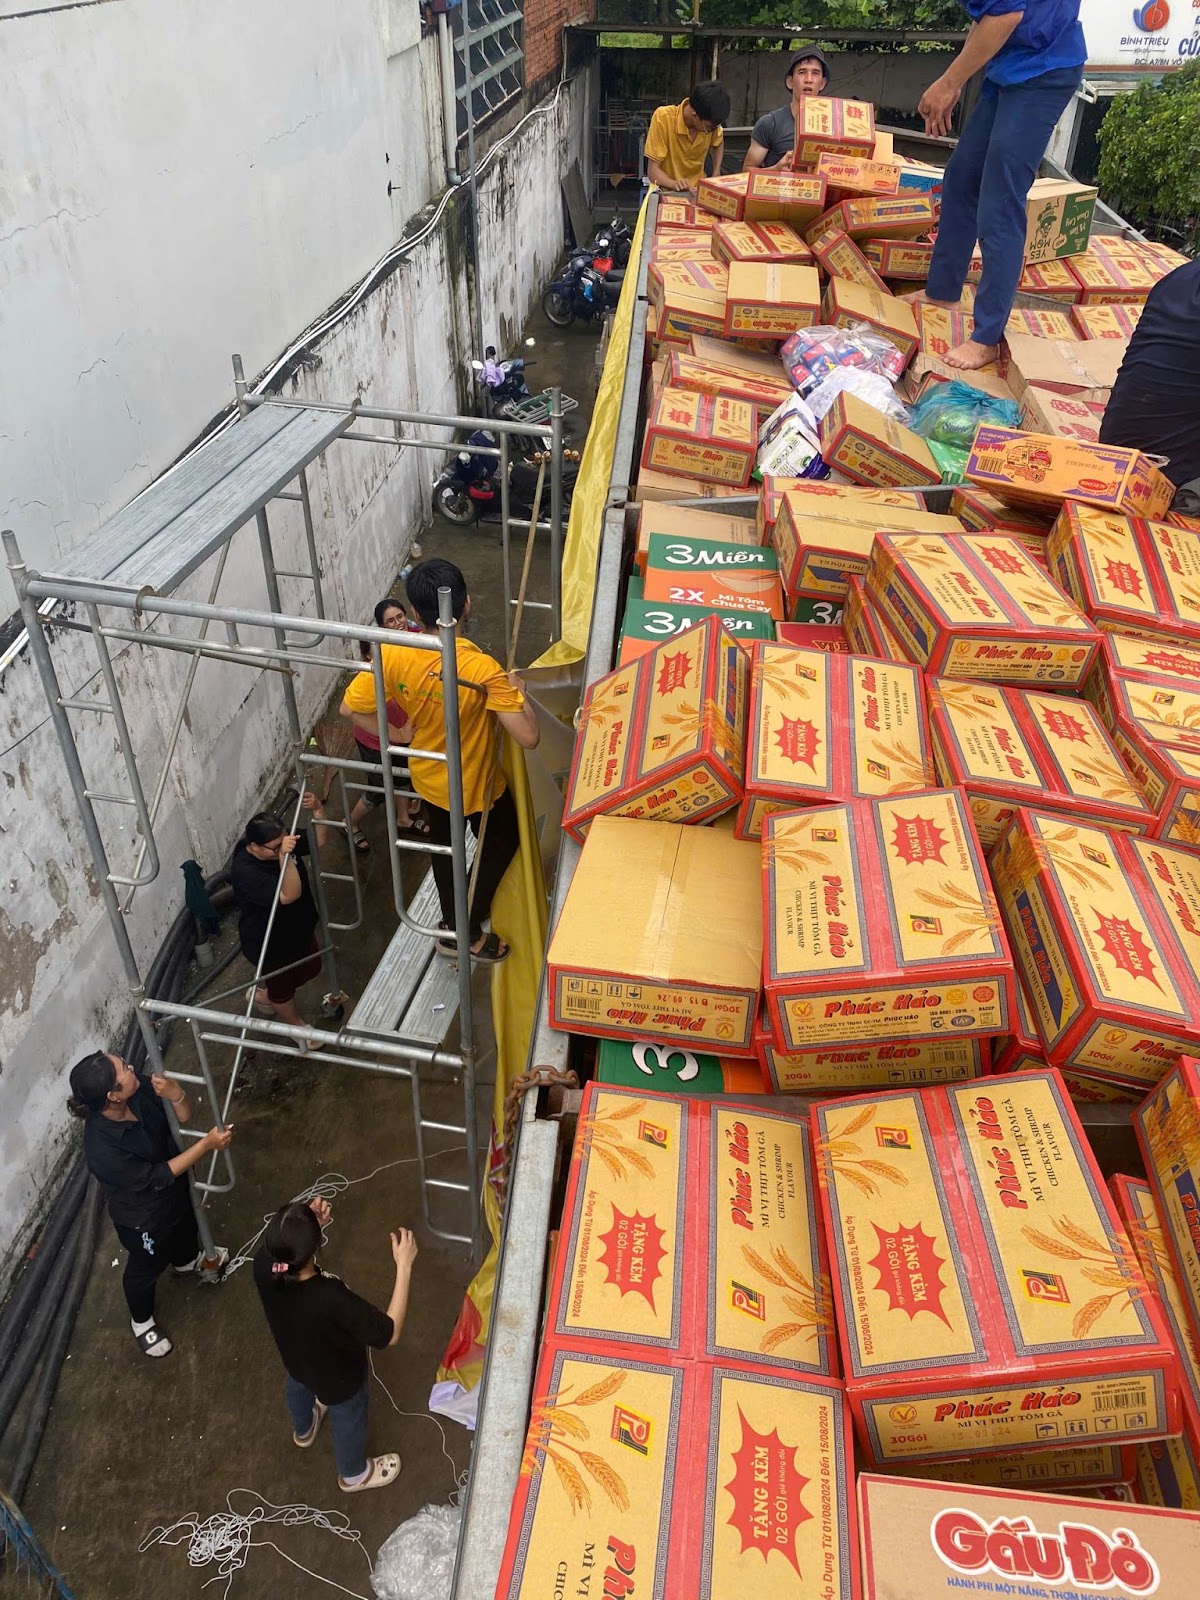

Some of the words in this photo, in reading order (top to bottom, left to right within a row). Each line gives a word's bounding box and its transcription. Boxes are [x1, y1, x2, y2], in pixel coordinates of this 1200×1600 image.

[1120, 35, 1141, 45] BÌNH
[1144, 37, 1169, 47] TRIỆU
[1178, 31, 1200, 56] CỬ
[1030, 251, 1046, 259] YES
[669, 588, 704, 602] 2X
[711, 599, 744, 609] Chua
[747, 602, 772, 613] Cay
[974, 645, 1018, 660] Phúc
[1020, 645, 1053, 661] Hảo
[822, 875, 846, 916] Phúc
[828, 921, 854, 958] Hảo
[606, 1007, 648, 1026] Hảo
[824, 997, 886, 1019] Phúc
[892, 989, 942, 1011] Hảo
[652, 1012, 707, 1032] Phúc
[904, 1013, 919, 1021] HẢO
[1001, 1098, 1014, 1113] GÀ
[969, 1097, 1004, 1141] Hảo
[1008, 1115, 1023, 1141] TÔM
[1024, 1107, 1041, 1138] SHRIMP
[725, 1121, 750, 1165] Hảo
[756, 1131, 766, 1145] GÀ
[1042, 1123, 1063, 1161] FLAVOUR
[757, 1146, 767, 1169] TÔM
[774, 1144, 782, 1172] SHRIMP
[1017, 1143, 1033, 1169] THỊT
[1039, 1147, 1059, 1187] CHICKEN
[760, 1171, 769, 1197] THỊT
[786, 1162, 795, 1199] FLAVOUR
[987, 1146, 1028, 1210] Phúc
[1027, 1171, 1037, 1184] VỊ
[728, 1167, 753, 1231] Phúc
[760, 1198, 770, 1211] VỊ
[776, 1180, 785, 1219] CHICKEN
[1030, 1186, 1045, 1202] MÌ
[619, 1220, 629, 1230] 02
[759, 1213, 770, 1228] MÌ
[845, 1215, 856, 1225] Áp
[630, 1222, 648, 1255] TẶNG
[847, 1226, 856, 1245] Dụng
[885, 1238, 896, 1249] 02
[851, 1245, 859, 1256] Từ
[887, 1251, 901, 1270] GÓI
[900, 1235, 920, 1270] TẶNG
[630, 1256, 646, 1283] KÈM
[852, 1256, 865, 1295] 01/08/2024
[572, 1279, 585, 1318] 15/08/2024
[909, 1272, 928, 1302] KÈM
[858, 1296, 866, 1312] Đến
[860, 1313, 874, 1356] 15/08/2024
[934, 1397, 1013, 1422] Phúc
[1020, 1385, 1081, 1410] Hảo
[819, 1405, 829, 1448] 15/08/2024
[957, 1419, 973, 1429] MÌ
[974, 1418, 988, 1427] VỊ
[990, 1415, 1016, 1425] THỊT
[1018, 1412, 1044, 1423] TÔM
[1046, 1409, 1063, 1418] GÀ
[889, 1433, 927, 1445] 30Gói
[751, 1446, 769, 1483] KÈM
[821, 1456, 830, 1475] Đến
[749, 1488, 773, 1539] TẶNG
[774, 1496, 788, 1523] GÓI
[819, 1478, 831, 1533] 01/08/2024
[776, 1527, 788, 1544] 02
[821, 1535, 832, 1549] Từ
[580, 1541, 596, 1569] MÌ
[823, 1552, 834, 1582] Dụng
[578, 1574, 592, 1598] VỊ
[821, 1586, 832, 1600] Áp
[947, 1576, 976, 1589] HÀNH
[977, 1581, 994, 1591] PHI
[995, 1584, 1015, 1595] MỘT
[1018, 1586, 1049, 1599] NẮNG,
[1050, 1589, 1079, 1600] THƠM
